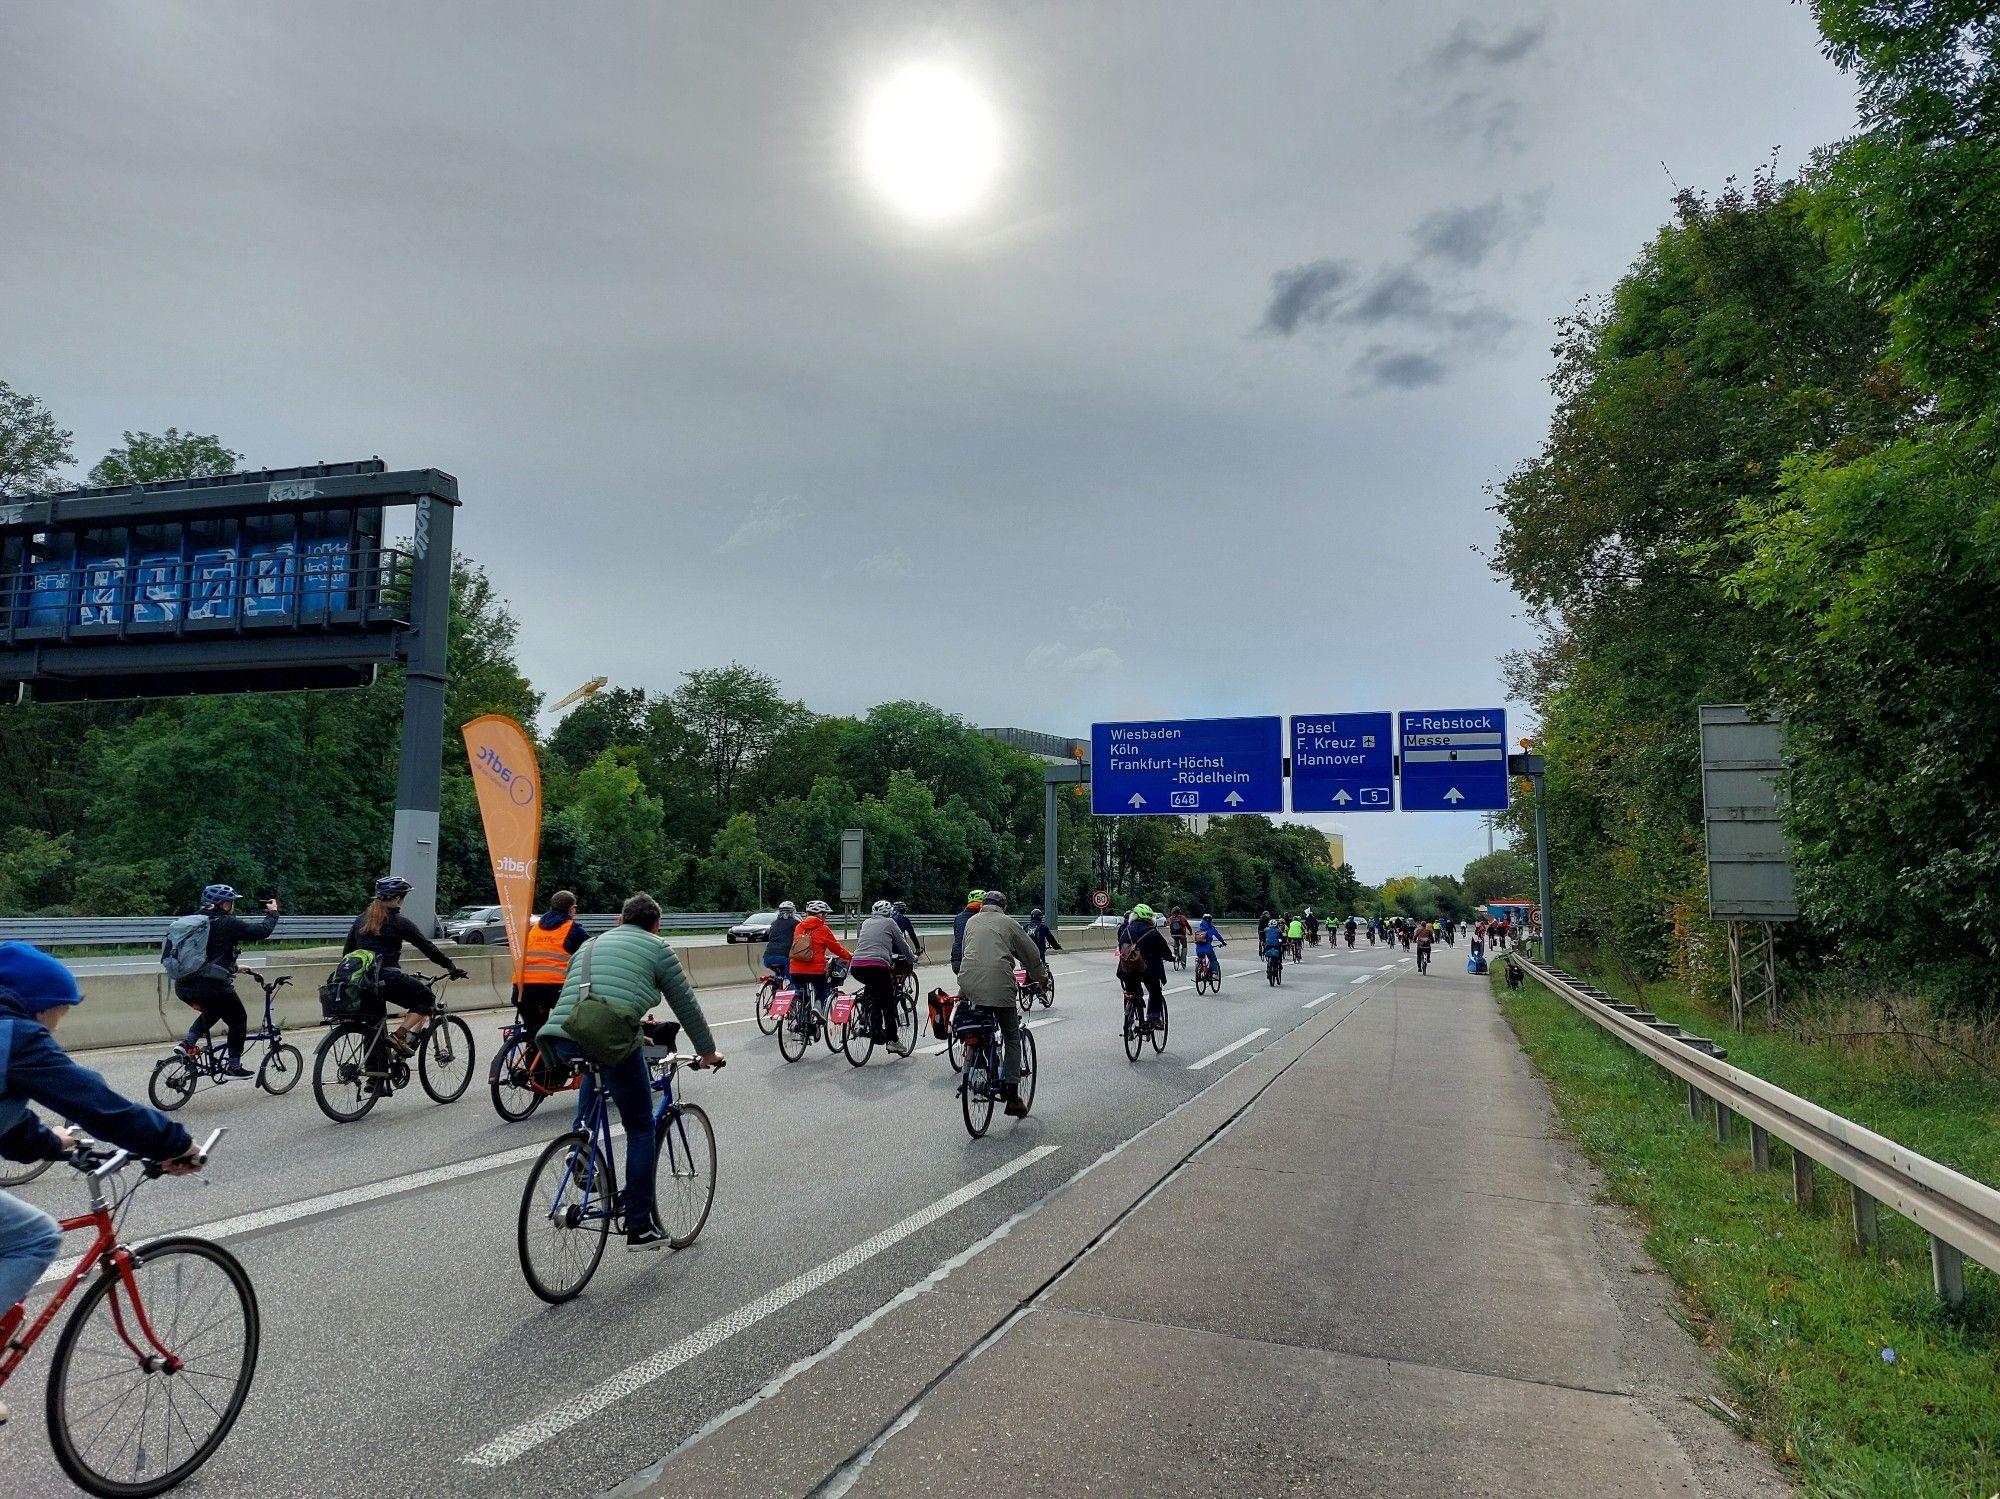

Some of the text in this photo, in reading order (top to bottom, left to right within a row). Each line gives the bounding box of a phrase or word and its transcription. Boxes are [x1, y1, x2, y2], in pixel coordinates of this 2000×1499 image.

[1296, 721, 1337, 734] Basel
[1405, 715, 1491, 731] F-Rebstock
[1110, 727, 1182, 740] Wiesbaden
[1296, 737, 1357, 750] F. Kreuz
[1405, 735, 1452, 746] Messe
[1109, 743, 1139, 756] Köln
[1109, 756, 1225, 771] Frankfurt-Höchst
[1296, 753, 1366, 766] Hannover
[1172, 770, 1250, 785] -Rödelheim
[1173, 794, 1196, 805] 648
[1370, 791, 1379, 802] 5
